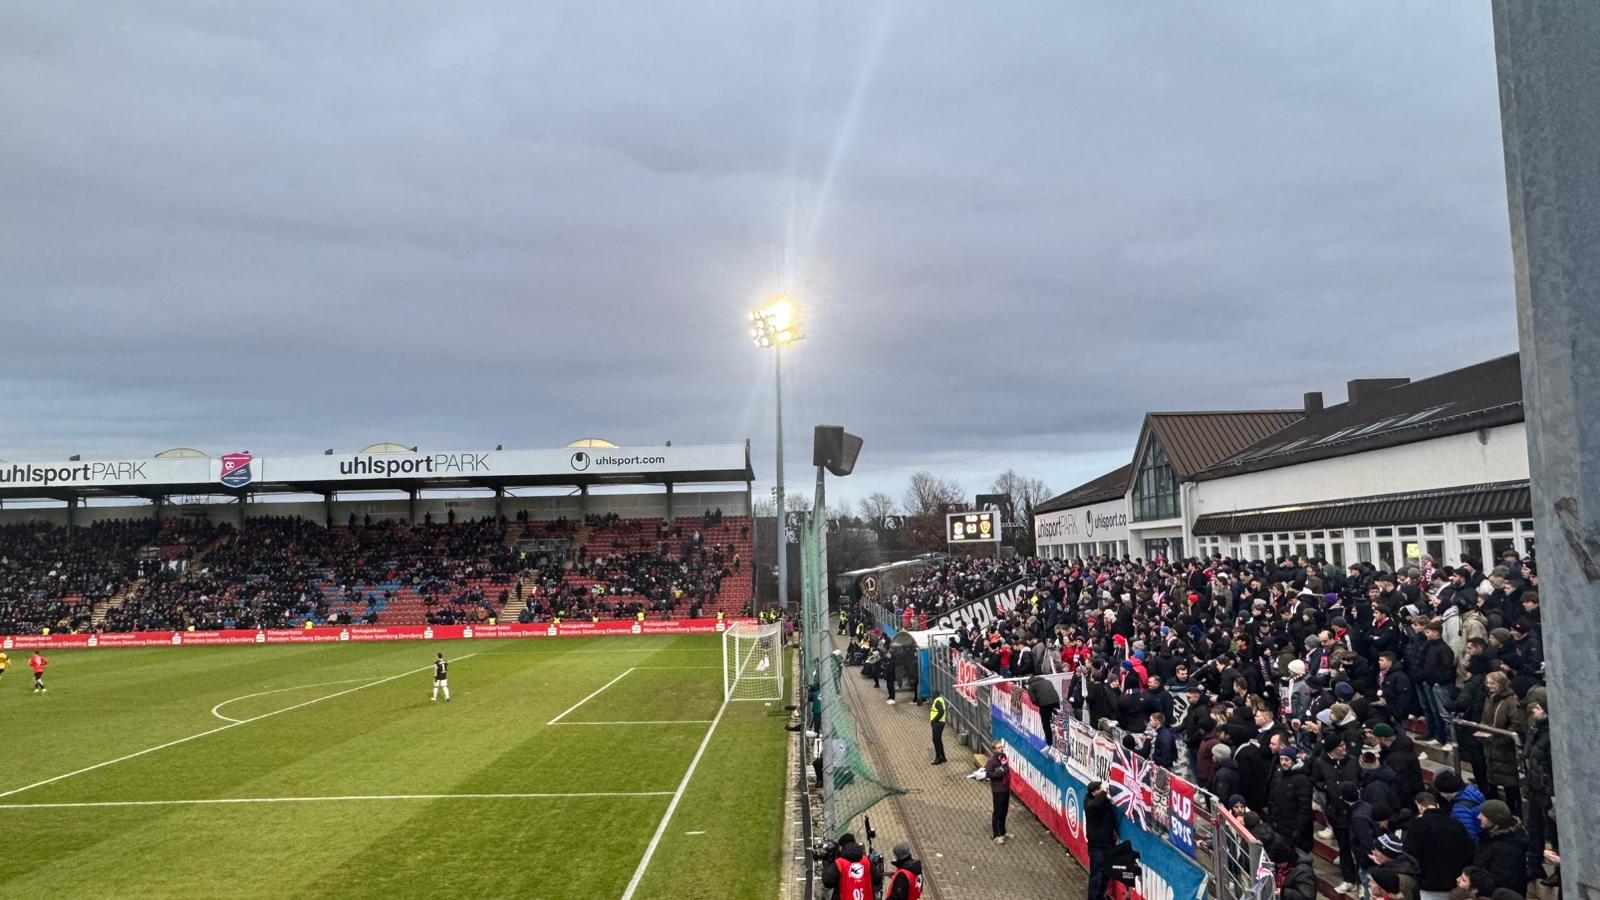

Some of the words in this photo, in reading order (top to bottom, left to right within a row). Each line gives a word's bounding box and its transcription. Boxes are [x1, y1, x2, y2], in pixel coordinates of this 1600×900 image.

[341, 453, 490, 477] uhlsportPARK
[595, 456, 665, 467] uhlsport.com
[1171, 790, 1191, 820] OLD
